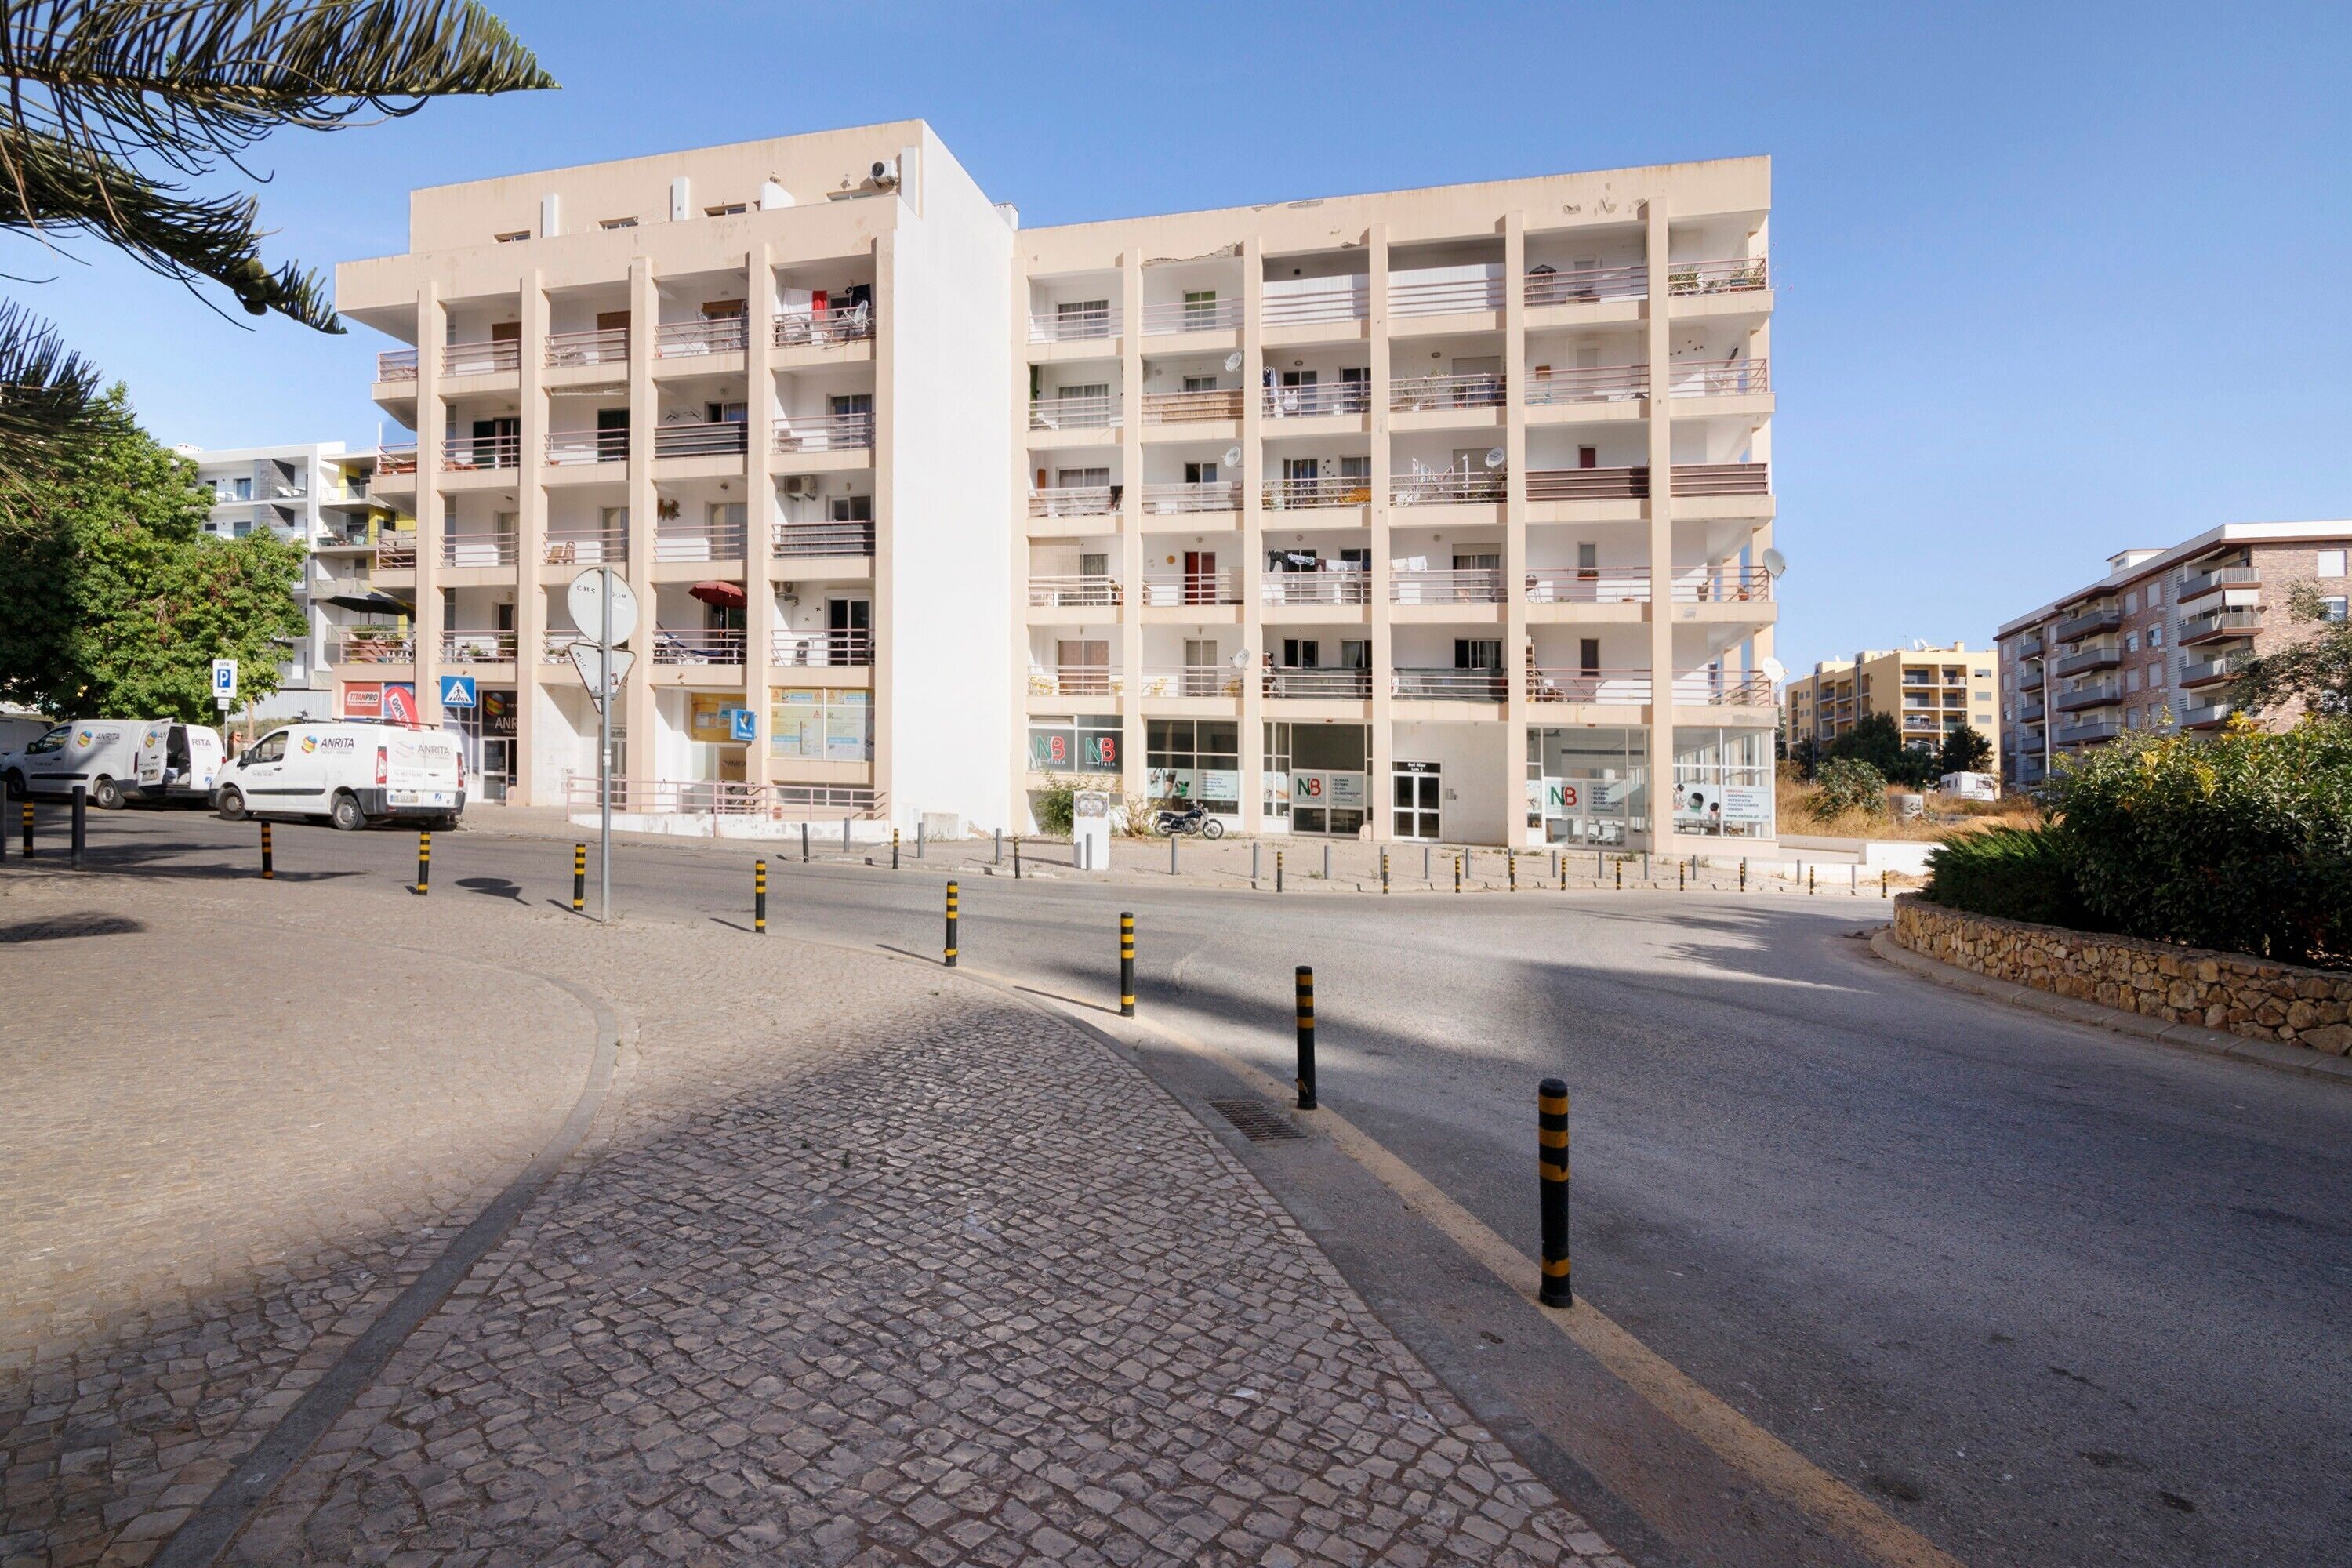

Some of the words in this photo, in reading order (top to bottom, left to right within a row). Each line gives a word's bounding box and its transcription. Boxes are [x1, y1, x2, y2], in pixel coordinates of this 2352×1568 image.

[220, 670, 228, 687] P
[350, 693, 379, 702] TITANPRO
[96, 732, 120, 741] ANRITA
[321, 737, 354, 748] ANRITA
[417, 744, 451, 755] ANRITA
[1036, 735, 1066, 761] NB
[1085, 737, 1116, 762] NB
[1298, 778, 1322, 796] NB
[1550, 786, 1577, 806] NB
